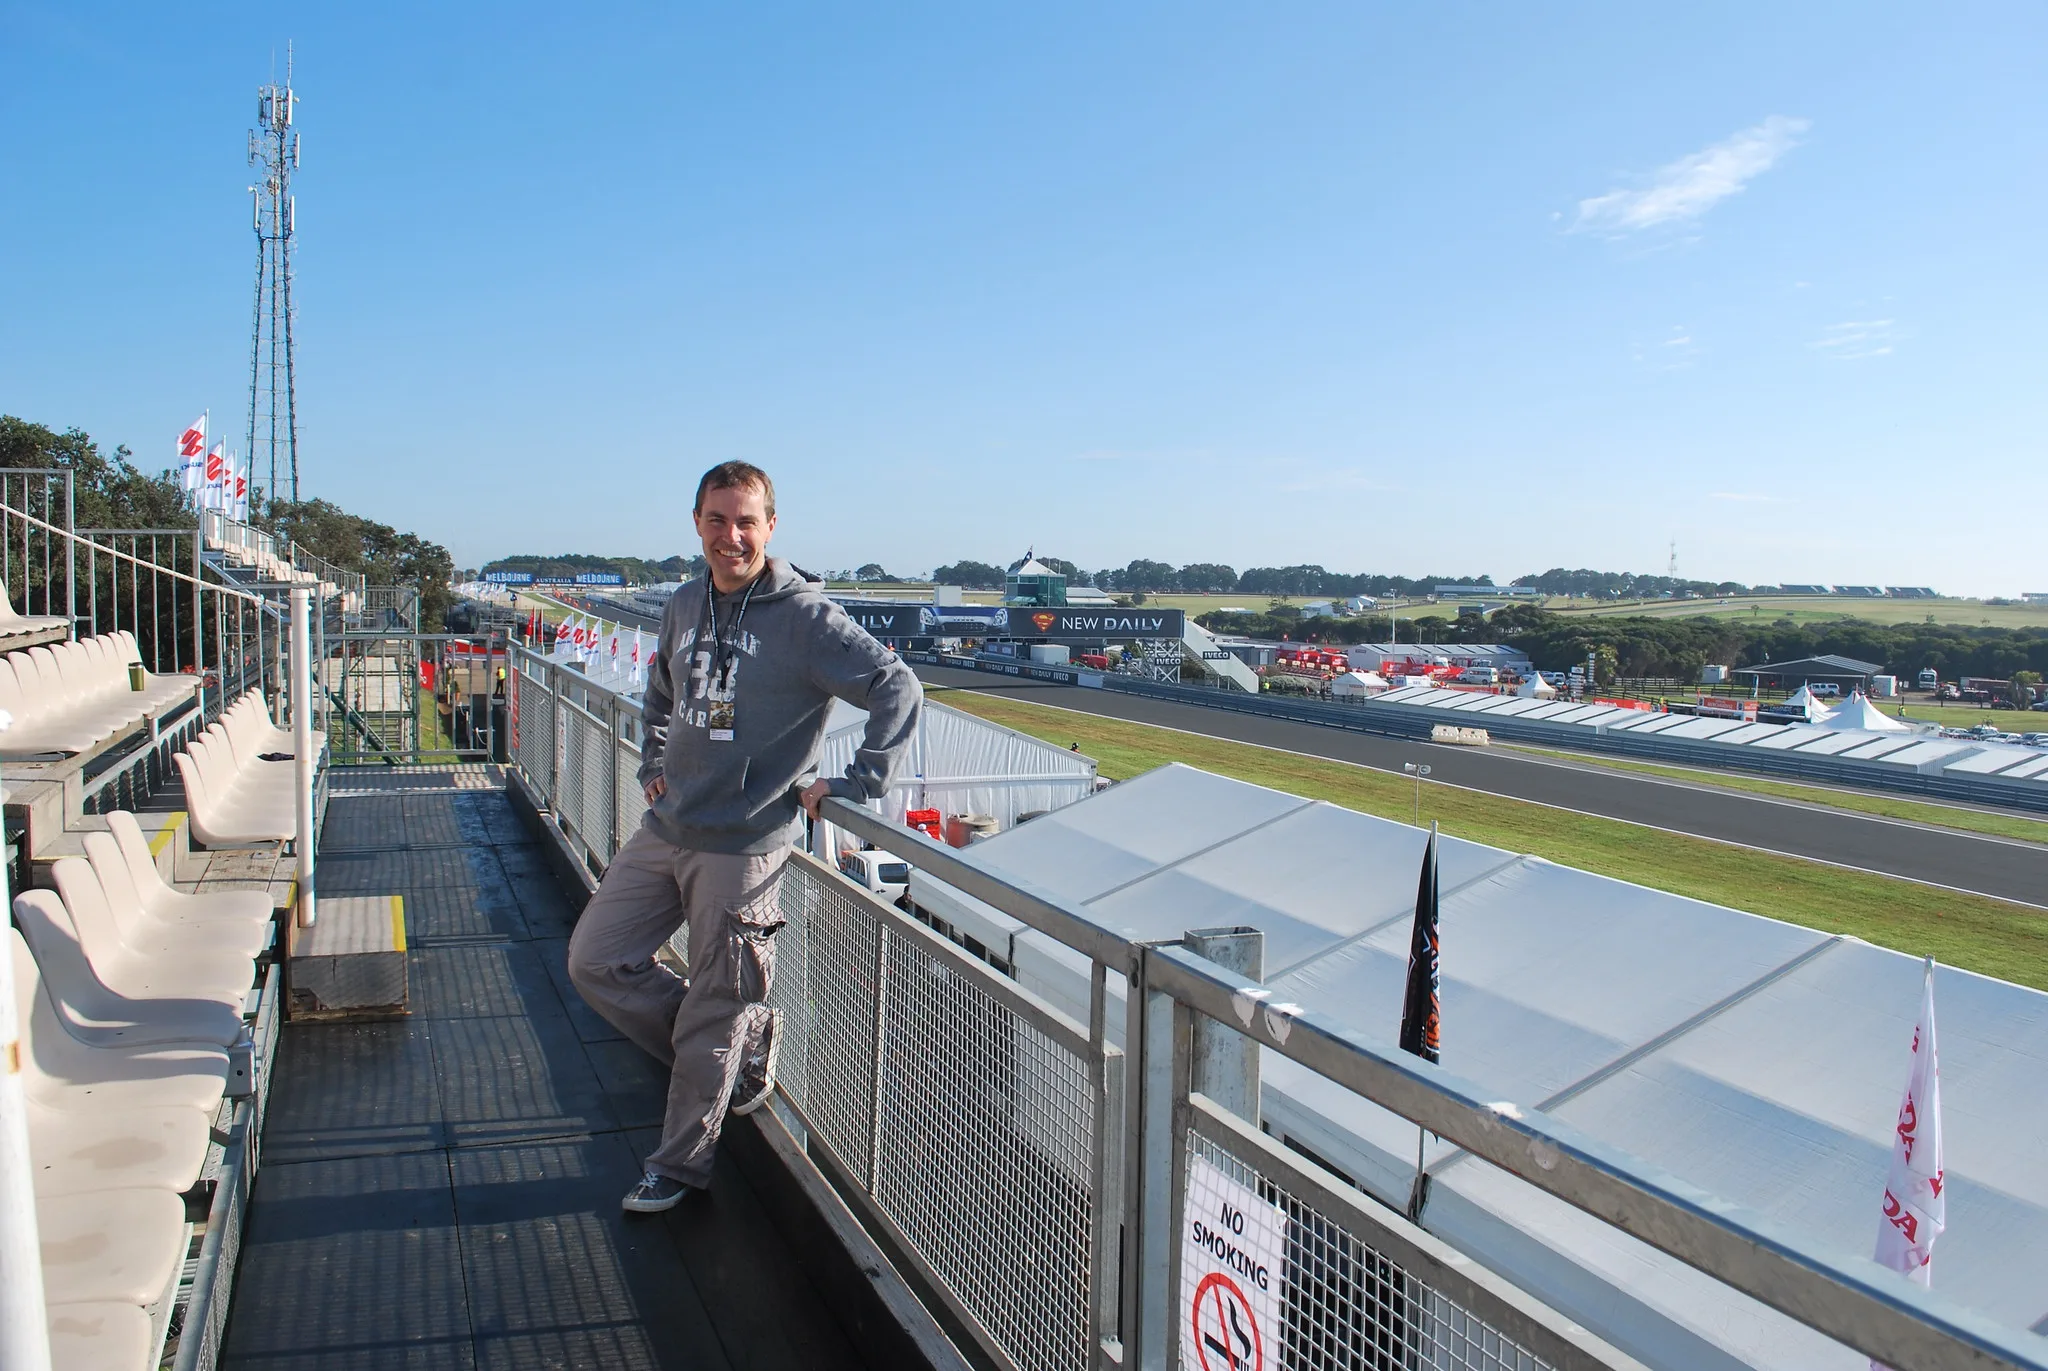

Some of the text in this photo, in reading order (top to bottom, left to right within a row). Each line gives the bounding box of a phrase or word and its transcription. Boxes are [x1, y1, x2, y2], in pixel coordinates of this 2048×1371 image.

[485, 572, 531, 582] MELBOURNE
[576, 574, 620, 584] MELBOURNE
[1062, 617, 1164, 631] NEW DAILY
[1156, 657, 1182, 665] IVECO
[1005, 665, 1019, 675] IVECO
[1053, 672, 1069, 681] IVECO
[1220, 1202, 1244, 1236] NO
[1192, 1220, 1269, 1291] SMOKING
